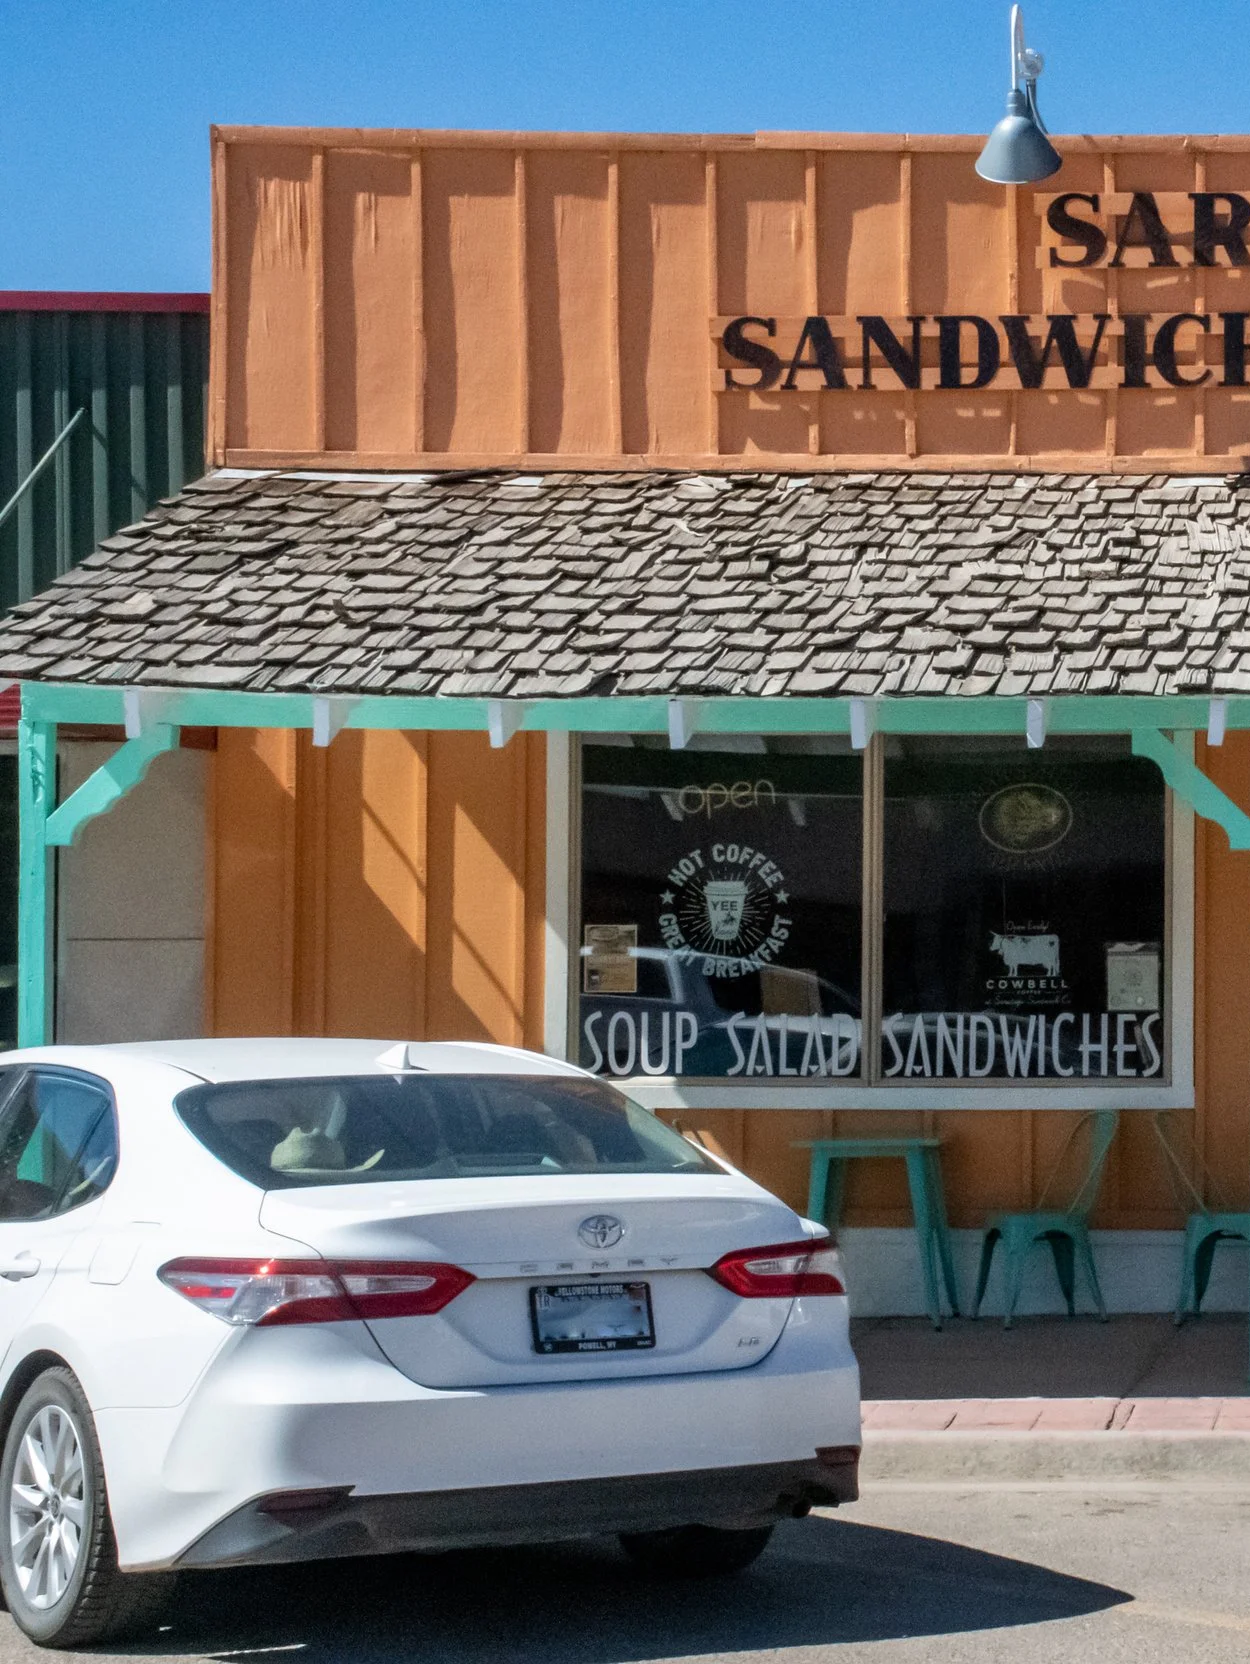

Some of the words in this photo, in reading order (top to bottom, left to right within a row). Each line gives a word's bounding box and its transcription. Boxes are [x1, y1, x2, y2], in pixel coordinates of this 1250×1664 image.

[678, 779, 776, 820] open
[668, 849, 705, 887] HOT
[711, 843, 785, 888] COFFEE
[711, 900, 738, 912] YEE
[659, 913, 697, 966] GREAT
[702, 914, 793, 978] BREAKFAST
[985, 979, 1069, 990] COWBELL
[584, 1011, 698, 1076] SOUP
[727, 1011, 858, 1076] SALAD
[884, 1012, 1161, 1078] SANDWICHES
[600, 1284, 624, 1295] MOTORS
